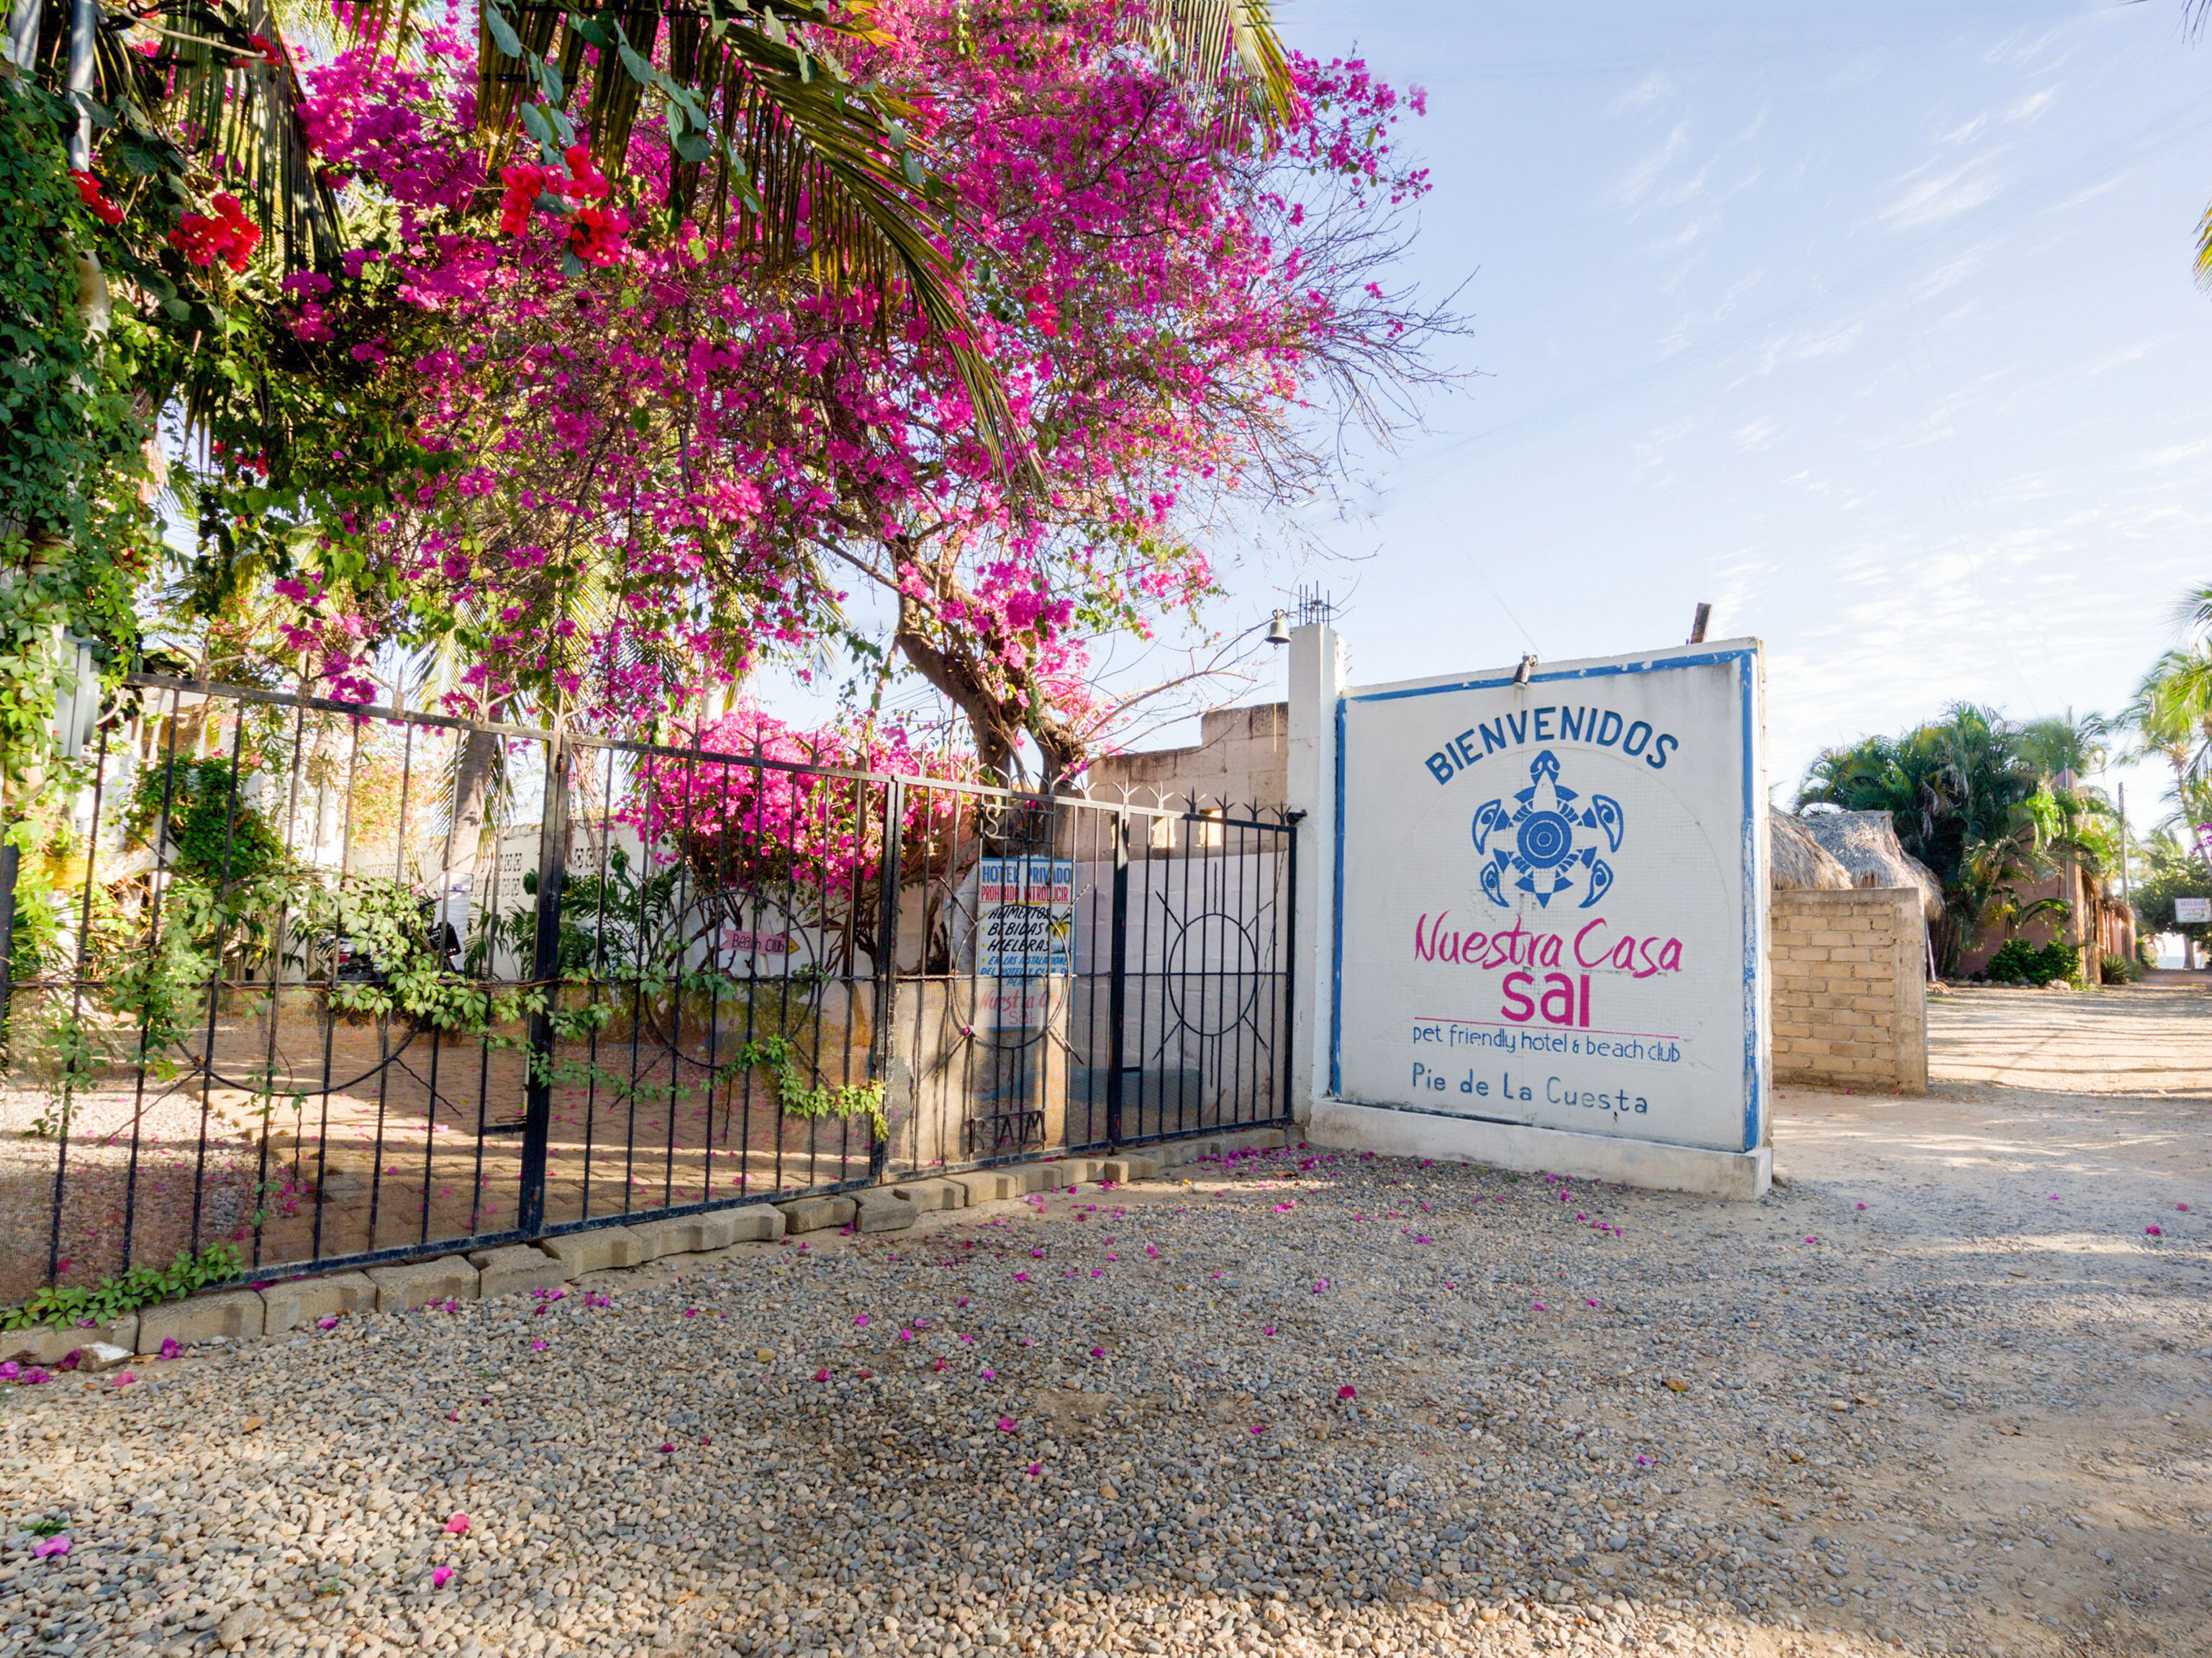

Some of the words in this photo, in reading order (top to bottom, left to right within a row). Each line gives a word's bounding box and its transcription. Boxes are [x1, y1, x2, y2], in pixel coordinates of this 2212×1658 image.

[1425, 705, 1679, 785] BIENVENIDOS
[982, 865, 1017, 883] HOTEL
[981, 885, 1020, 901] PROHBIDO
[987, 922, 1045, 936] BEBIDAS
[987, 938, 1050, 952] HIELERAS
[1414, 910, 1564, 970] Nuestra
[1574, 918, 1683, 979] Casa
[979, 967, 997, 976] DEL
[979, 989, 1035, 1013] Nuesta
[1413, 1024, 1443, 1044] pet
[1449, 1024, 1515, 1054] friendly
[1520, 1030, 1567, 1053] hotel
[1572, 1039, 1580, 1054] &
[1586, 1035, 1644, 1059] beach
[1648, 1041, 1681, 1063] club
[1412, 1061, 1446, 1092] Pie
[1460, 1068, 1490, 1096] de
[1503, 1072, 1533, 1102] La
[1546, 1076, 1648, 1115] Cuesta
